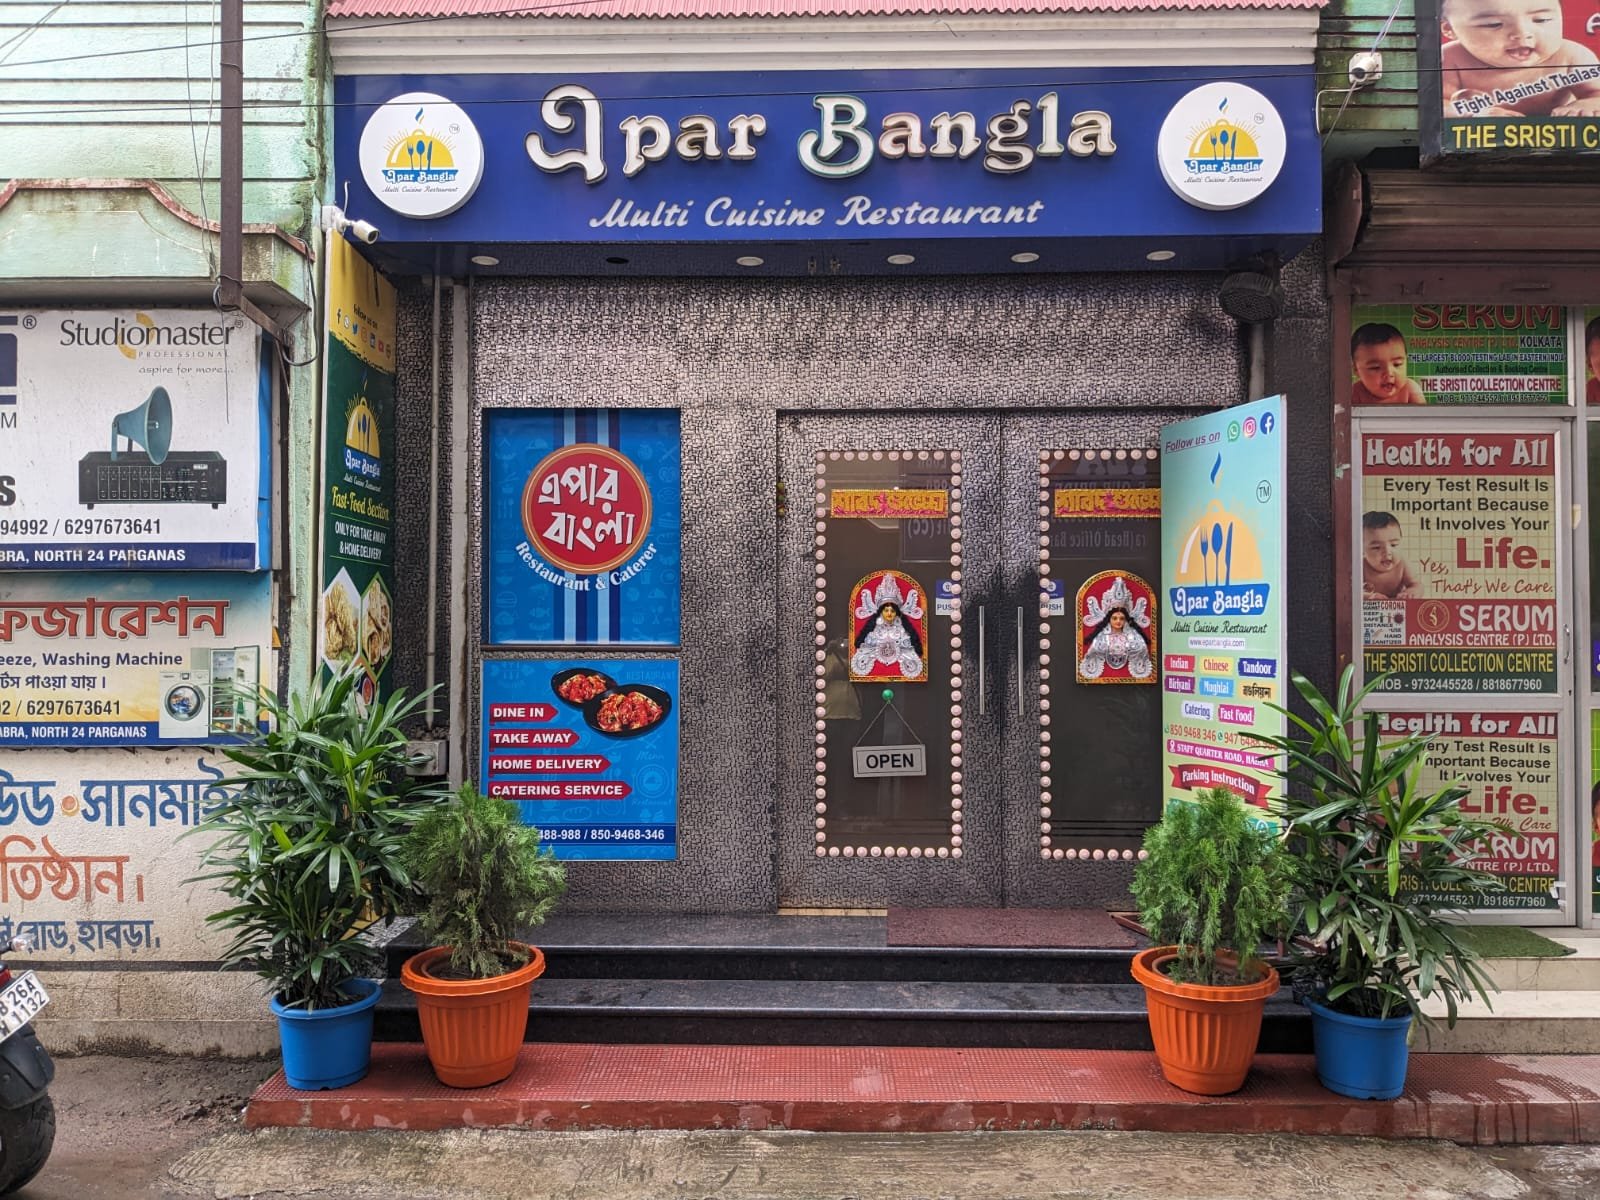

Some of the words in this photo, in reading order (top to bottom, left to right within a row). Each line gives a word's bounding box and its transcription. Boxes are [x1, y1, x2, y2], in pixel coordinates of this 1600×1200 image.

[1453, 95, 1493, 115] Fight
[1495, 79, 1549, 104] Against
[798, 90, 1117, 178] Bangla
[1452, 125, 1497, 149] THE
[1504, 125, 1576, 148] SRISTI
[1221, 161, 1261, 175] Bangla
[417, 171, 455, 184] Bangla
[589, 197, 694, 228] Multi
[704, 196, 826, 228] Cuisine
[835, 194, 1045, 227] Restaurant
[60, 316, 236, 347] Studiomaster
[1520, 336, 1562, 347] KOLKATA
[1422, 353, 1449, 362] LARGEST
[1450, 353, 1471, 362] BLOOD
[1472, 353, 1498, 362] TESTING
[139, 365, 174, 376] aspire
[177, 363, 192, 376] for
[1421, 378, 1438, 391] THE
[1440, 378, 1468, 391] SRISTI
[1470, 378, 1525, 391] COLLECTION
[1527, 378, 1562, 391] CENTRE
[1165, 438, 1192, 453] Follow
[1195, 435, 1206, 445] us
[1209, 432, 1221, 442] on
[1365, 438, 1452, 467] Health
[1461, 438, 1502, 467] for
[1511, 438, 1549, 467] All
[538, 463, 620, 514] এপার
[1383, 478, 1431, 494] Every
[1437, 478, 1471, 492] Test
[1477, 478, 1529, 492] Result
[1535, 478, 1549, 492] Is
[367, 497, 390, 521] Section
[1391, 498, 1472, 514] Important
[1478, 498, 1549, 511] Because
[64, 519, 161, 535] 6297673641
[542, 511, 635, 552] বাংলা
[1420, 517, 1430, 530] It
[1436, 517, 1506, 530] Involves
[1511, 517, 1549, 530] Your
[335, 521, 349, 536] ONLY
[350, 524, 360, 539] FOR
[360, 527, 373, 542] TAKE
[373, 531, 387, 544] AWAY
[34, 549, 83, 562] NORTH
[87, 549, 104, 562] 24
[108, 549, 186, 562] PARGANAS
[345, 542, 360, 557] HOME
[360, 545, 382, 560] DELIVERY
[1456, 537, 1550, 569] Life.
[515, 541, 590, 591] Restaurant
[595, 576, 606, 591] &
[610, 543, 658, 586] Caterer
[1420, 558, 1449, 575] Yes,
[1432, 578, 1481, 593] That's
[1486, 578, 1509, 593] We
[1514, 578, 1553, 593] Care.
[1213, 589, 1264, 615] Bangla
[1380, 601, 1405, 610] CORONA
[1458, 604, 1554, 632] SERUM
[1171, 621, 1191, 633] Multi
[1194, 620, 1219, 633] Cuisine
[1221, 621, 1268, 633] Restaurant
[1409, 633, 1463, 646] ANALYSIS
[1466, 633, 1509, 646] CENTRE
[1512, 633, 1529, 646] (P)
[1533, 633, 1555, 646] LTD.
[42, 652, 110, 669] Washing
[116, 651, 183, 666] Machine
[1170, 657, 1189, 669] Indian
[1203, 659, 1229, 672] Chinese
[1242, 661, 1272, 674] Tandoor
[1364, 652, 1387, 673] THE
[1390, 652, 1427, 673] SRISTI
[1430, 652, 1504, 673] COLLECTION
[1507, 652, 1554, 673] CENTRE
[25, 674, 67, 691] পাওয়া
[70, 674, 97, 691] যায়
[1376, 679, 1402, 690] MOB
[1411, 678, 1474, 691] 9732445528
[27, 700, 121, 715] 6297673641
[493, 707, 525, 718] DINE
[529, 707, 544, 717] IN
[1185, 703, 1211, 719] Catering
[1220, 707, 1234, 720] Fast
[1235, 709, 1253, 722] Food
[31, 726, 69, 738] NORTH
[71, 726, 85, 738] 24
[88, 725, 147, 738] PARGANAS
[1470, 713, 1510, 734] for
[1518, 715, 1555, 735] All
[493, 733, 529, 744] TAKE
[533, 733, 572, 744] AWAY
[1170, 724, 1182, 736] 850
[1184, 726, 1201, 739] 9468
[1203, 728, 1216, 741] 346
[1177, 743, 1193, 754] STAFF
[1195, 746, 1222, 760] QUARTER
[1224, 751, 1245, 764] ROAD,
[1454, 740, 1486, 753] Test
[1489, 740, 1534, 754] Result
[1538, 741, 1551, 754] Is
[492, 759, 532, 769] HOME
[536, 759, 602, 769] DELIVERY
[865, 753, 914, 769] OPEN
[1490, 756, 1551, 769] Because
[1182, 771, 1209, 784] Parking
[1211, 770, 1255, 795] Instruction
[1439, 770, 1448, 781] It
[1517, 771, 1551, 783] Your
[492, 785, 561, 796] CATERING
[564, 785, 623, 796] SERVICE
[1458, 785, 1549, 815] Life.
[1520, 816, 1552, 831] Care
[590, 829, 665, 840] 850-9468-346
[1503, 862, 1523, 872] (P)
[1527, 862, 1555, 873] LTD.
[1483, 895, 1546, 907] 8918677960
[12, 991, 46, 1024] 1132
